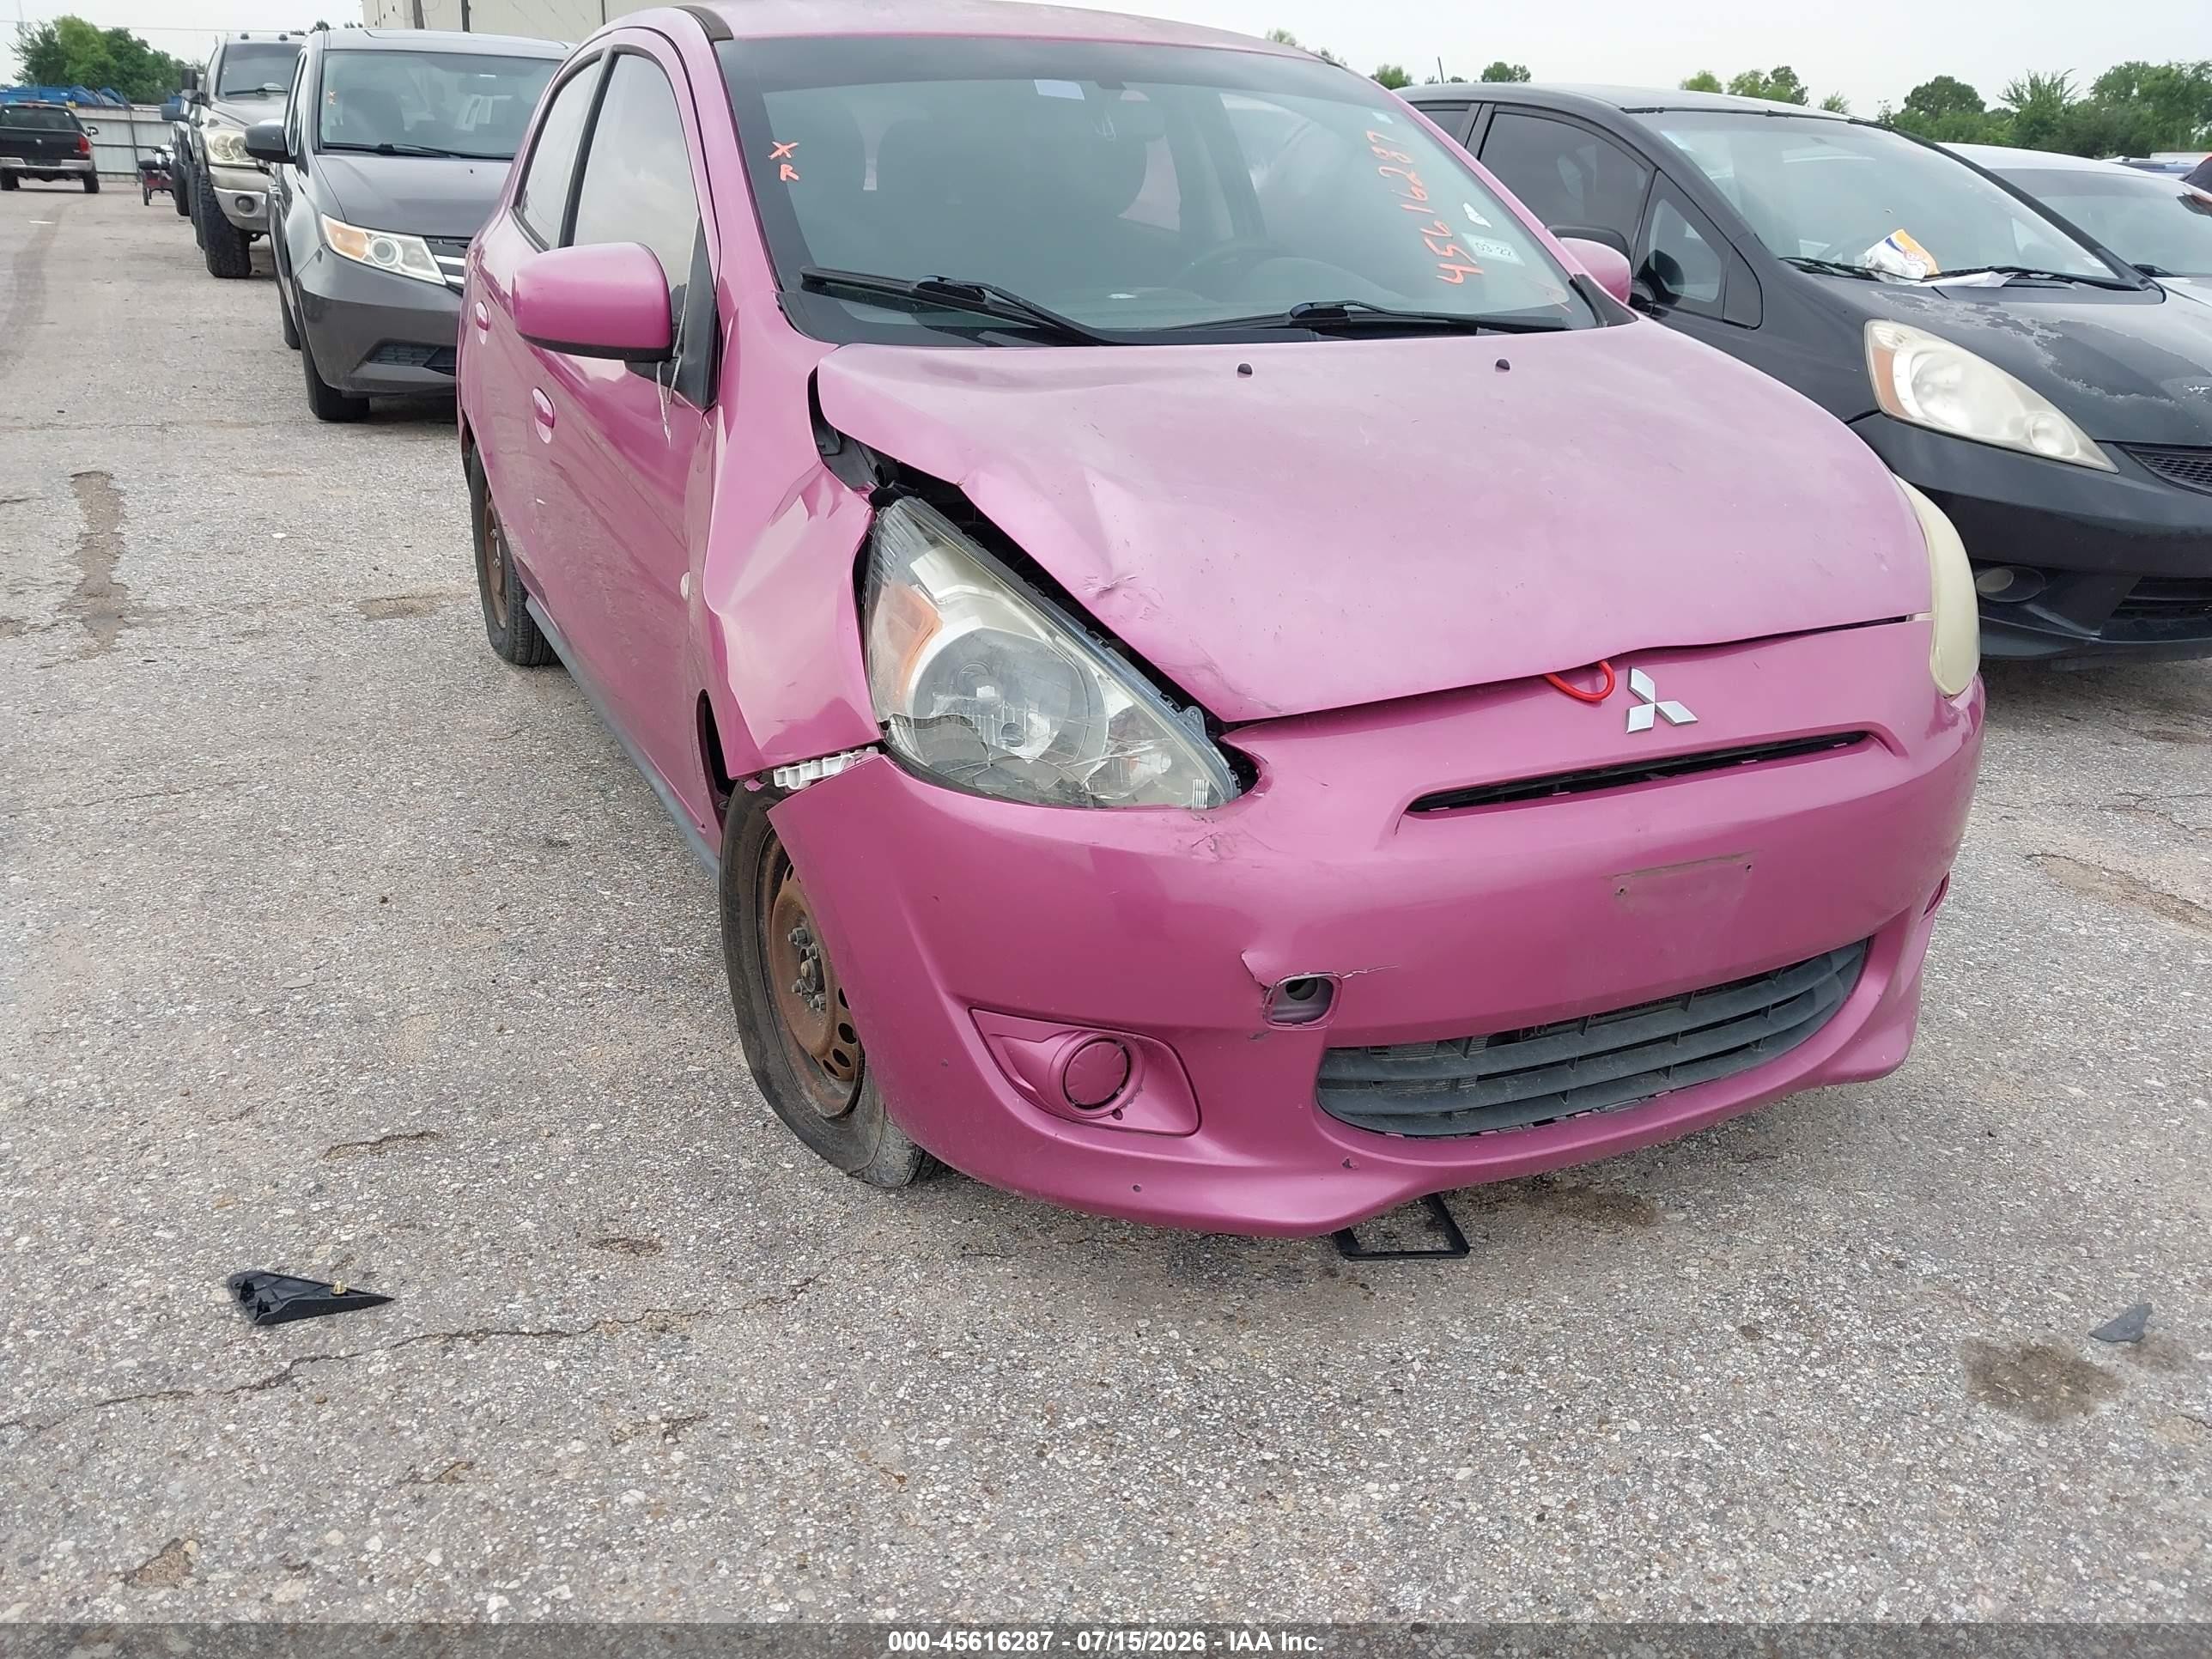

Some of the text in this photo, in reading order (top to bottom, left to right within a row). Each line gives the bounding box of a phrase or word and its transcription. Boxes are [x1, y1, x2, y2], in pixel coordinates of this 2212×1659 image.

[768, 141, 799, 160] X
[780, 163, 799, 181] R
[1366, 130, 1484, 284] 45616287
